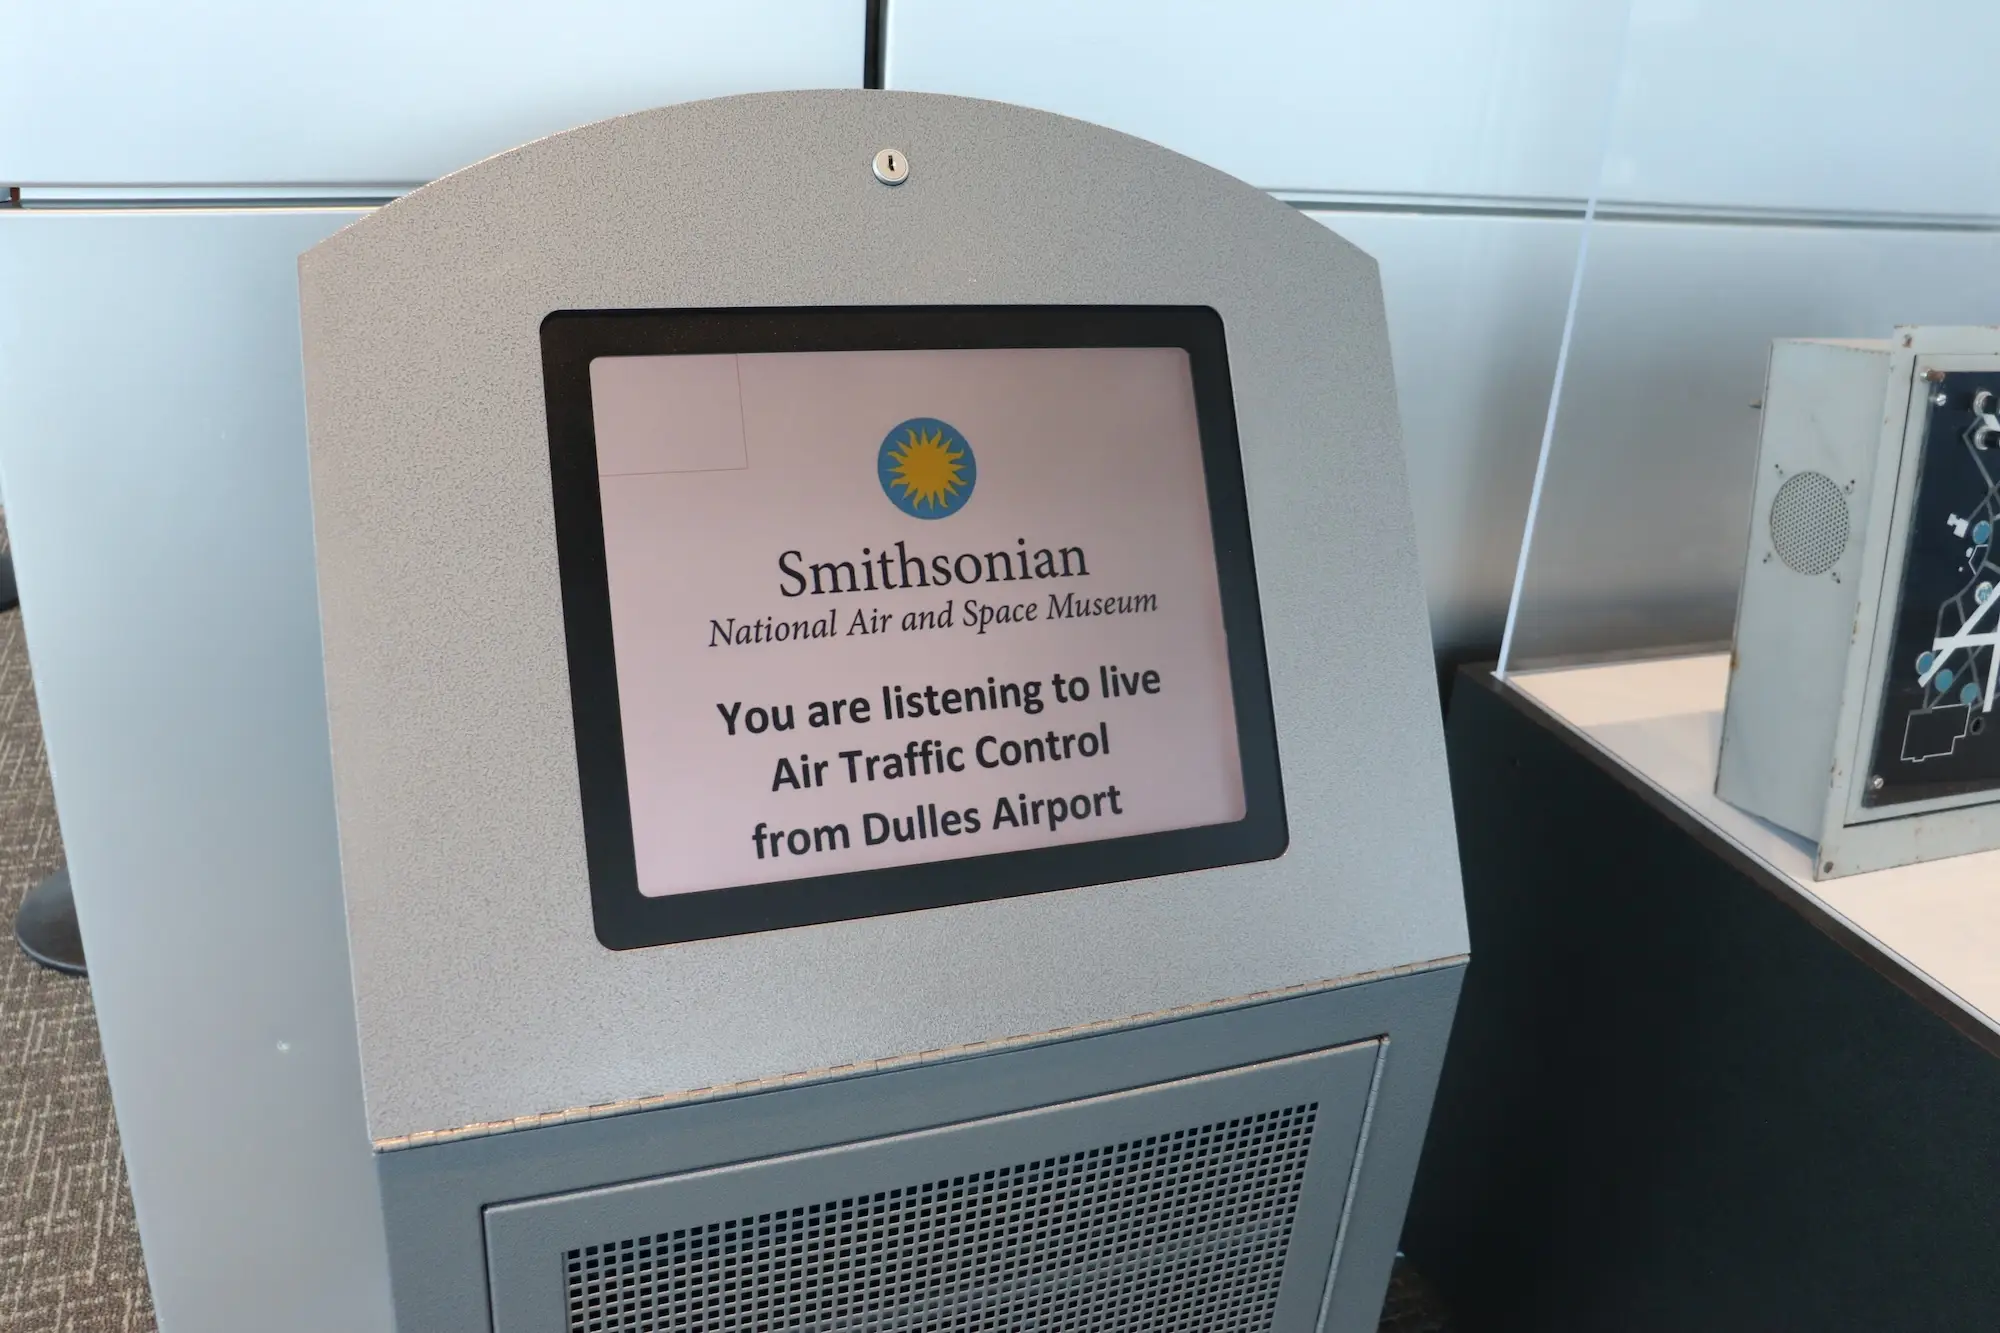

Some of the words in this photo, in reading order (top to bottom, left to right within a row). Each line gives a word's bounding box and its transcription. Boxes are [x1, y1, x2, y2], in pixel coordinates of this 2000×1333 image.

[778, 537, 1091, 598] Smithsonian
[707, 607, 838, 648] National
[845, 607, 894, 637] Air
[901, 599, 955, 632] and
[962, 599, 1038, 635] Space
[1045, 592, 1158, 620] Museum
[715, 701, 796, 737] You
[807, 696, 871, 729] are
[881, 676, 1045, 721] listening
[1051, 673, 1090, 704] to
[1099, 664, 1161, 699] live
[771, 753, 829, 793] Air
[837, 739, 966, 784] Traffic
[975, 721, 1110, 769] Control
[751, 821, 851, 860] from
[862, 802, 982, 847] Dulles
[992, 784, 1124, 832] Airport
